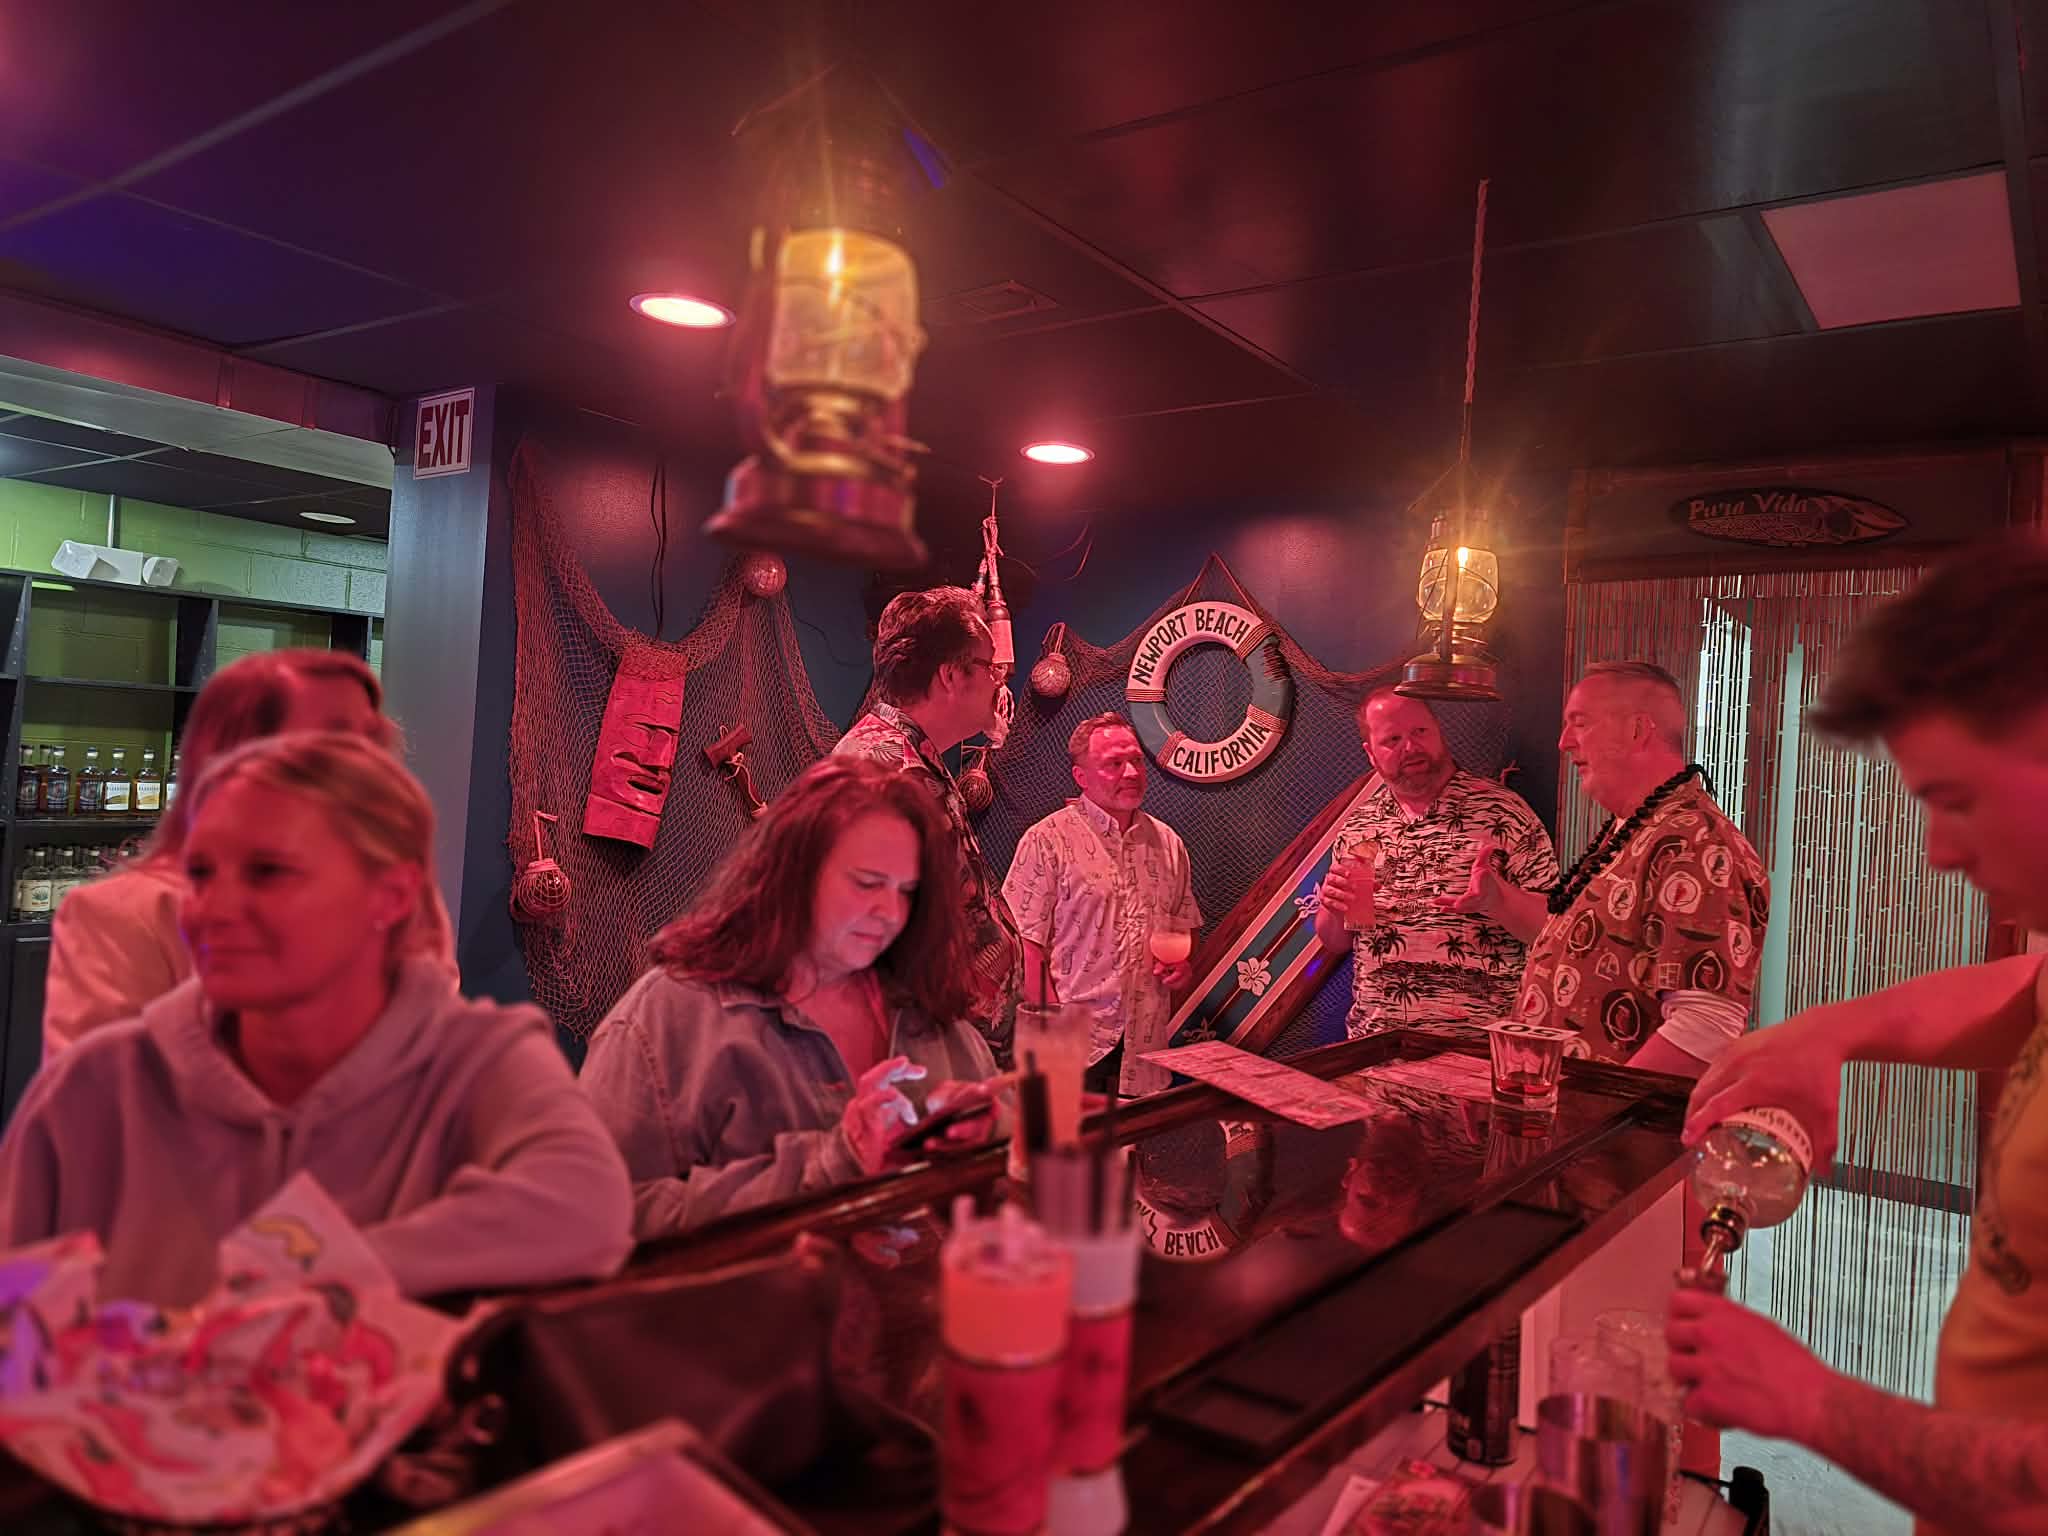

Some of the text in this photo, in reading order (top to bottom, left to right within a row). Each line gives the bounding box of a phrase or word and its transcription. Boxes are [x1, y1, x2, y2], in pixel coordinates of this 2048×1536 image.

[418, 399, 470, 469] EXIT
[1687, 492, 1808, 521] Pura Vida
[1132, 608, 1251, 685] NEWPORT BEACH
[1172, 722, 1271, 775] CALIFORNIA
